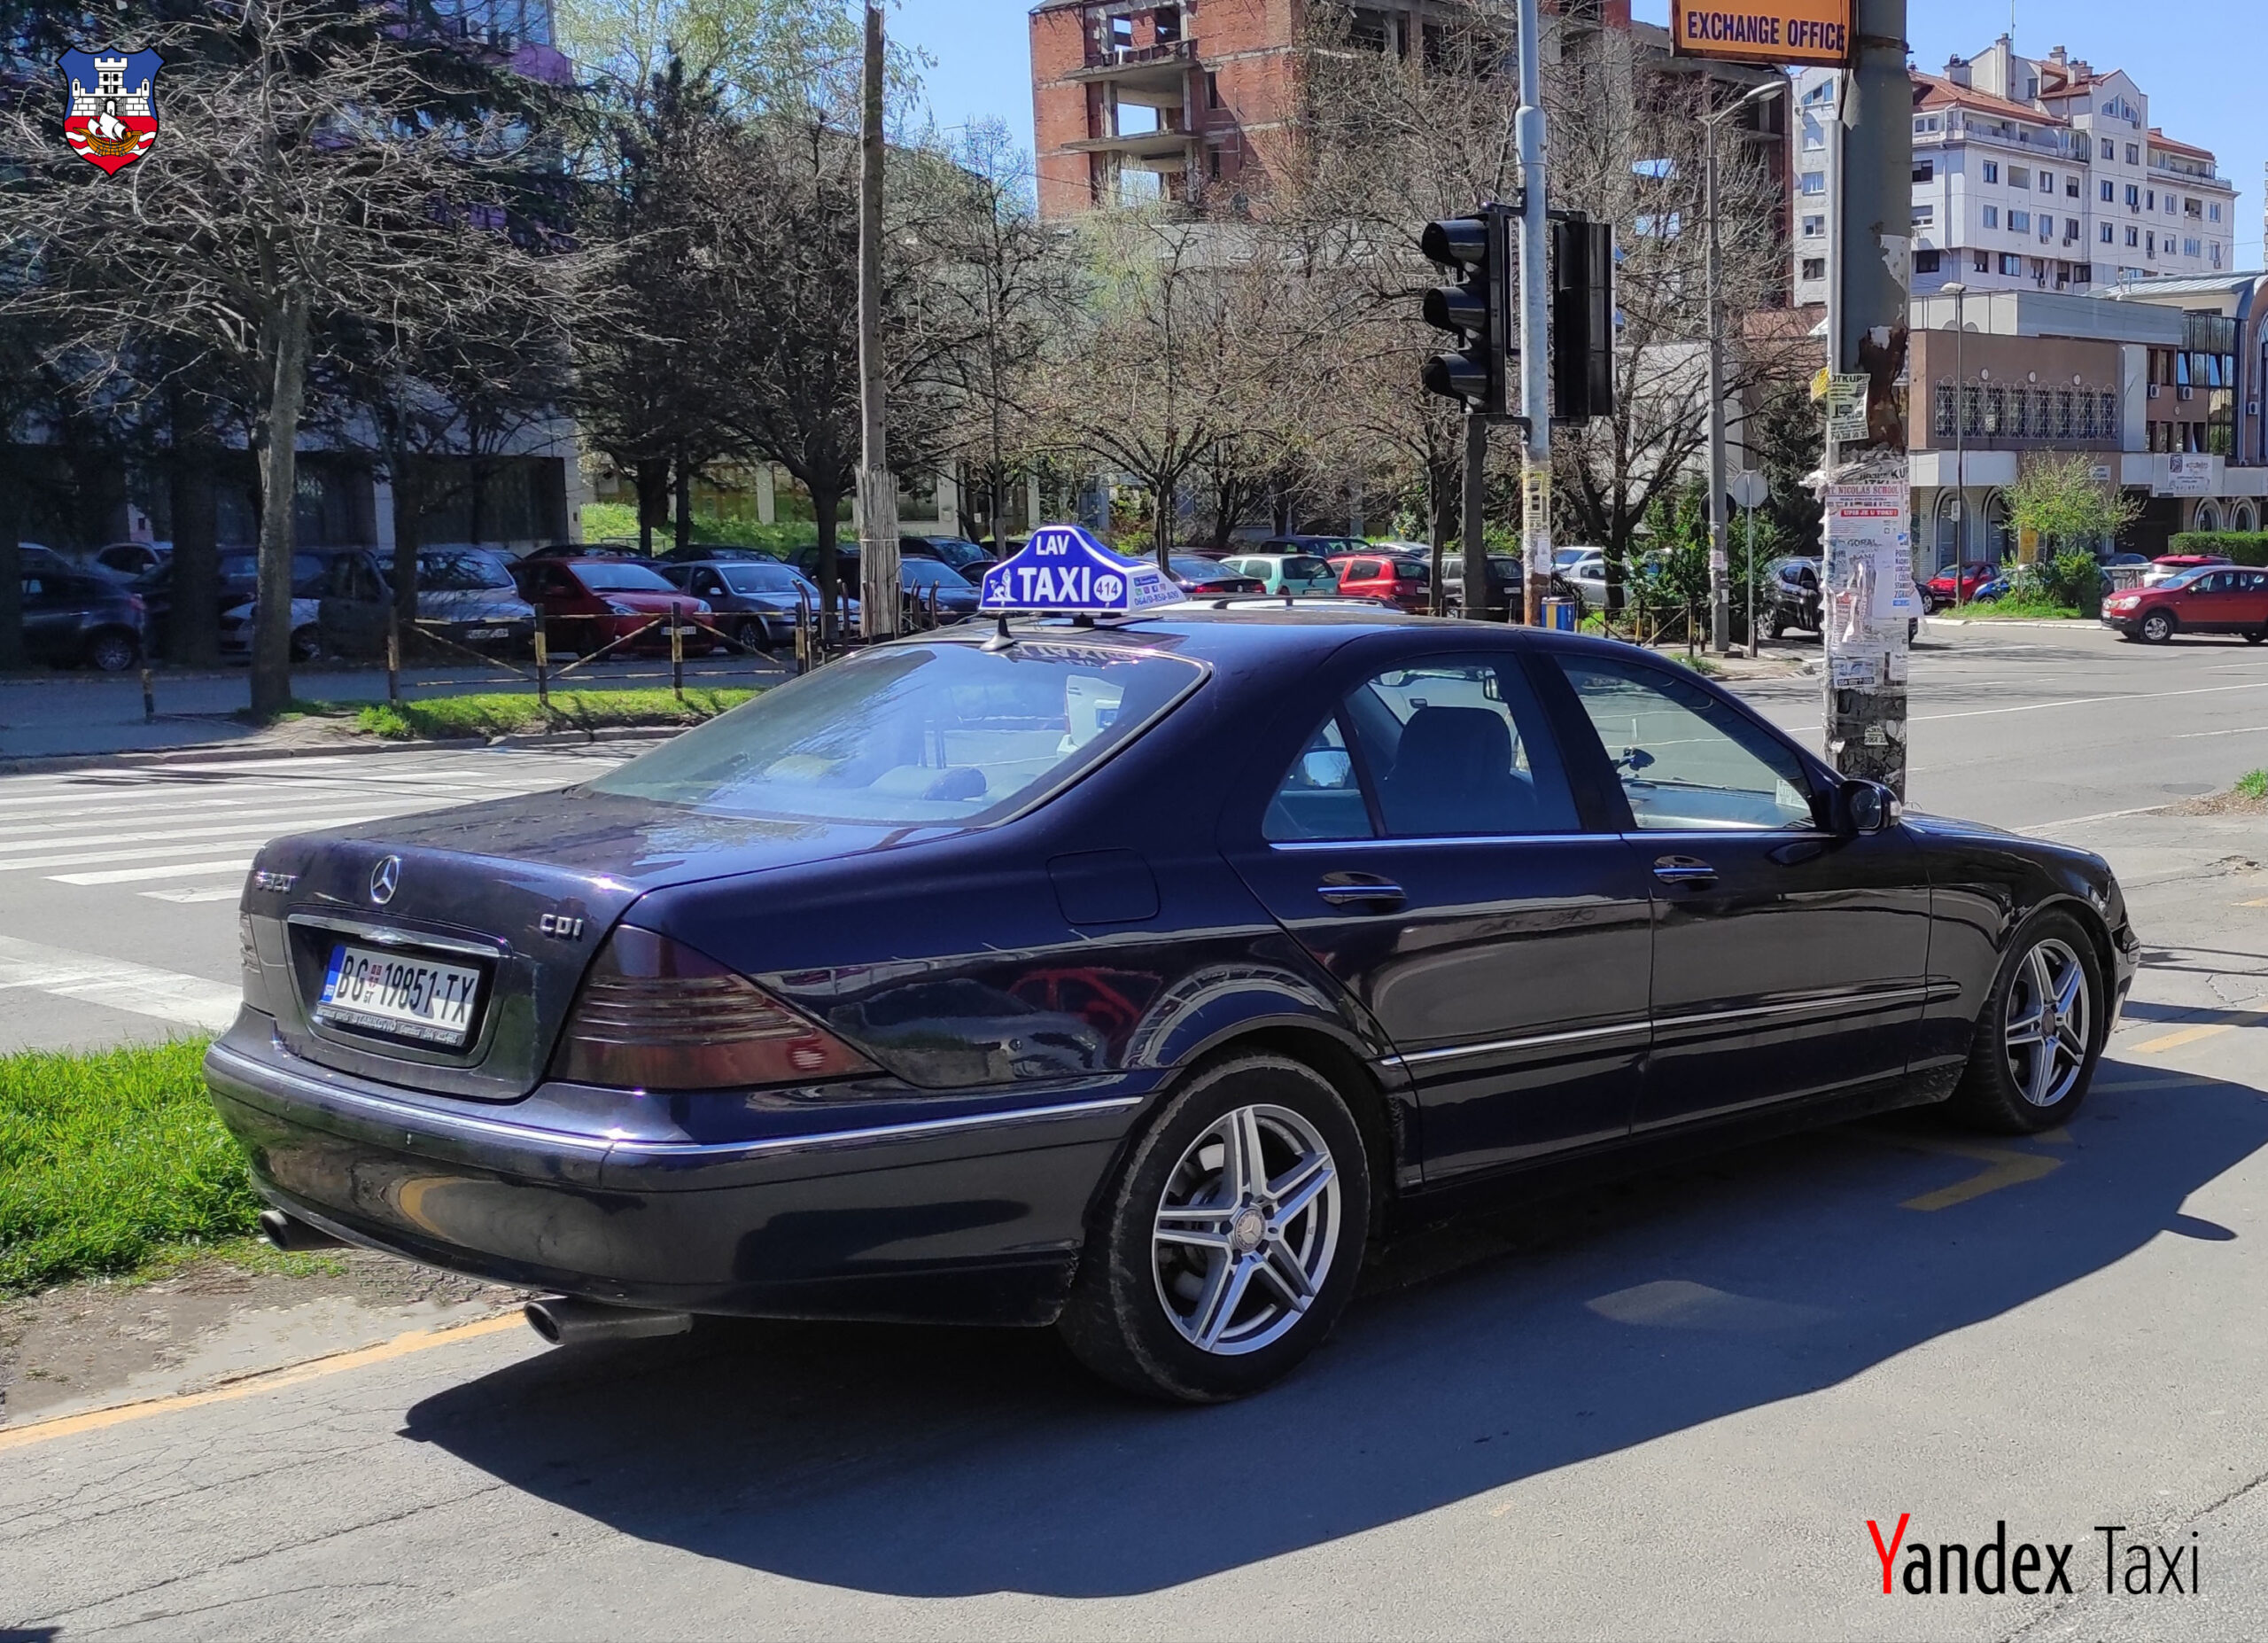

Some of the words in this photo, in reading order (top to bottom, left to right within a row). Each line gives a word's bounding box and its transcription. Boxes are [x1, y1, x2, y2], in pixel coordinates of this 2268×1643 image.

[1687, 11, 1780, 45] EXCHANGE
[1787, 19, 1845, 51] OFFICE
[1838, 485, 1870, 495] NICOLAS
[1873, 485, 1899, 494] SCHOOL
[1036, 534, 1070, 557] LAV
[1017, 566, 1091, 603] TAXI
[1096, 580, 1119, 596] 414
[540, 913, 584, 937] CDI
[336, 954, 369, 1002] BG
